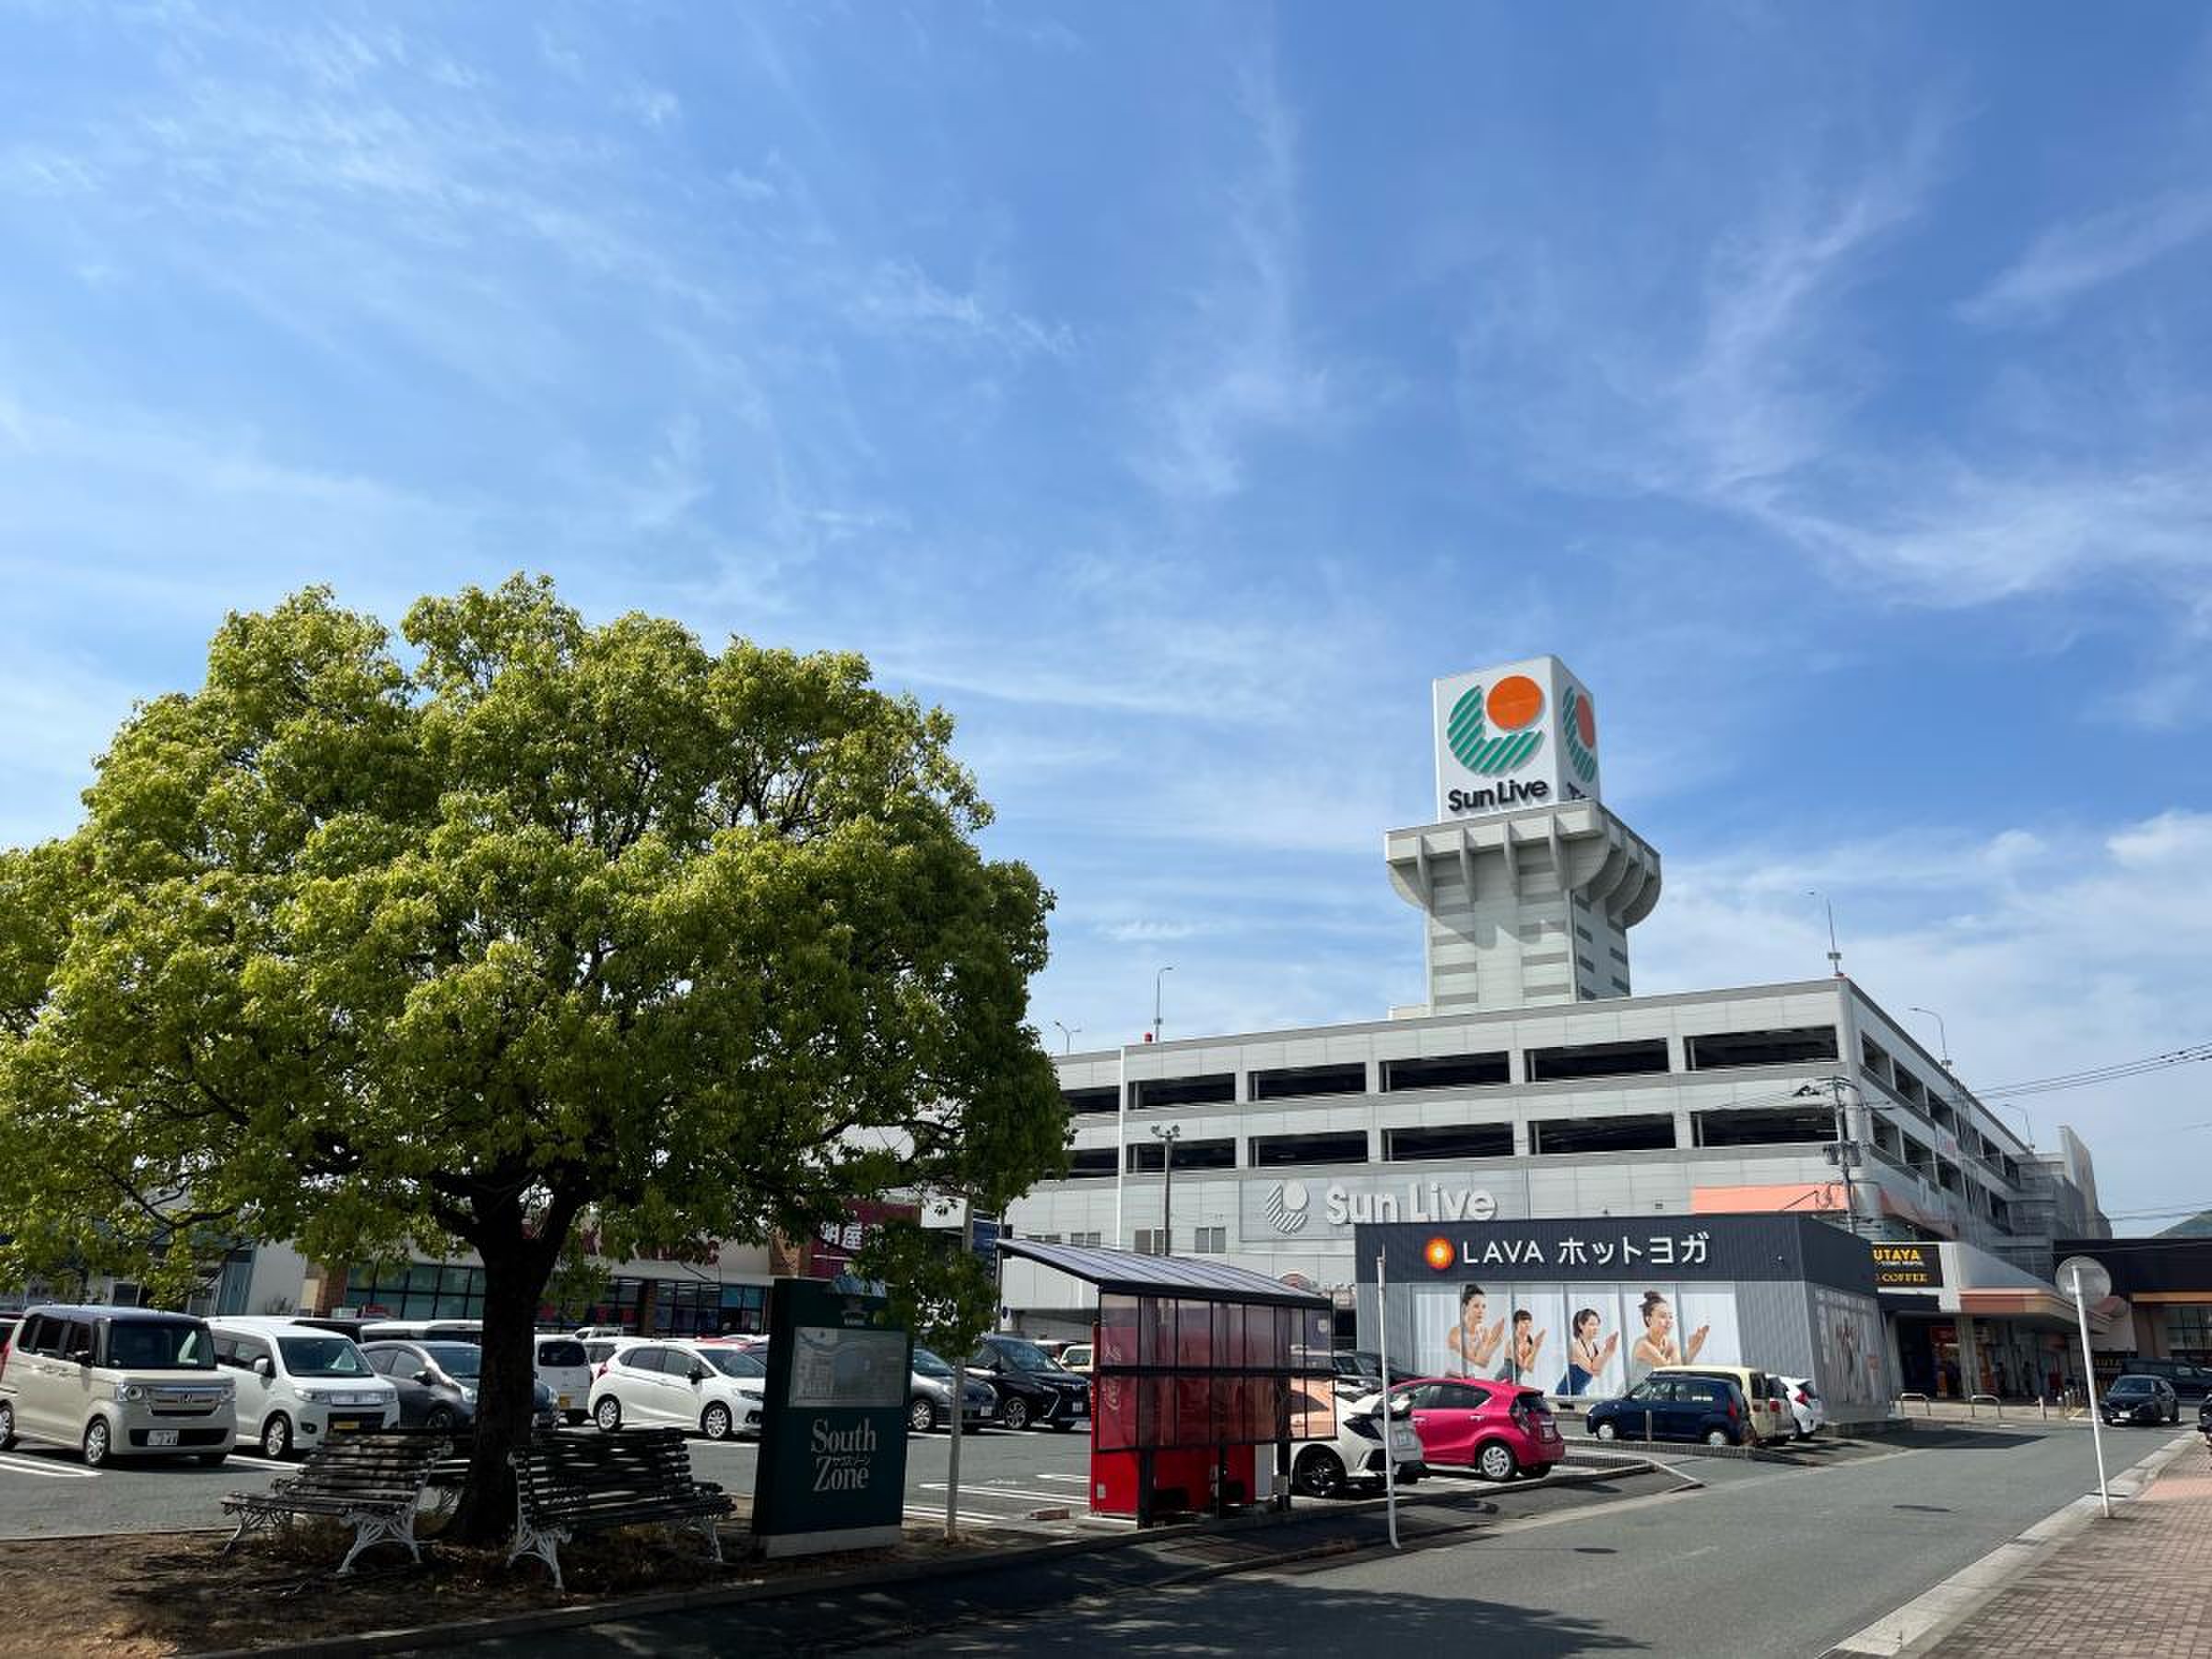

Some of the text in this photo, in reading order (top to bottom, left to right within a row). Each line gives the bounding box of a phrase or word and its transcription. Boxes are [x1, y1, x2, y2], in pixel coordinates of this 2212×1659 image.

[1327, 1182, 1497, 1224] Sun Live
[1463, 1231, 1711, 1265] LAVA ホットヨガ
[811, 1418, 877, 1453] South
[813, 1456, 869, 1491] Zone
